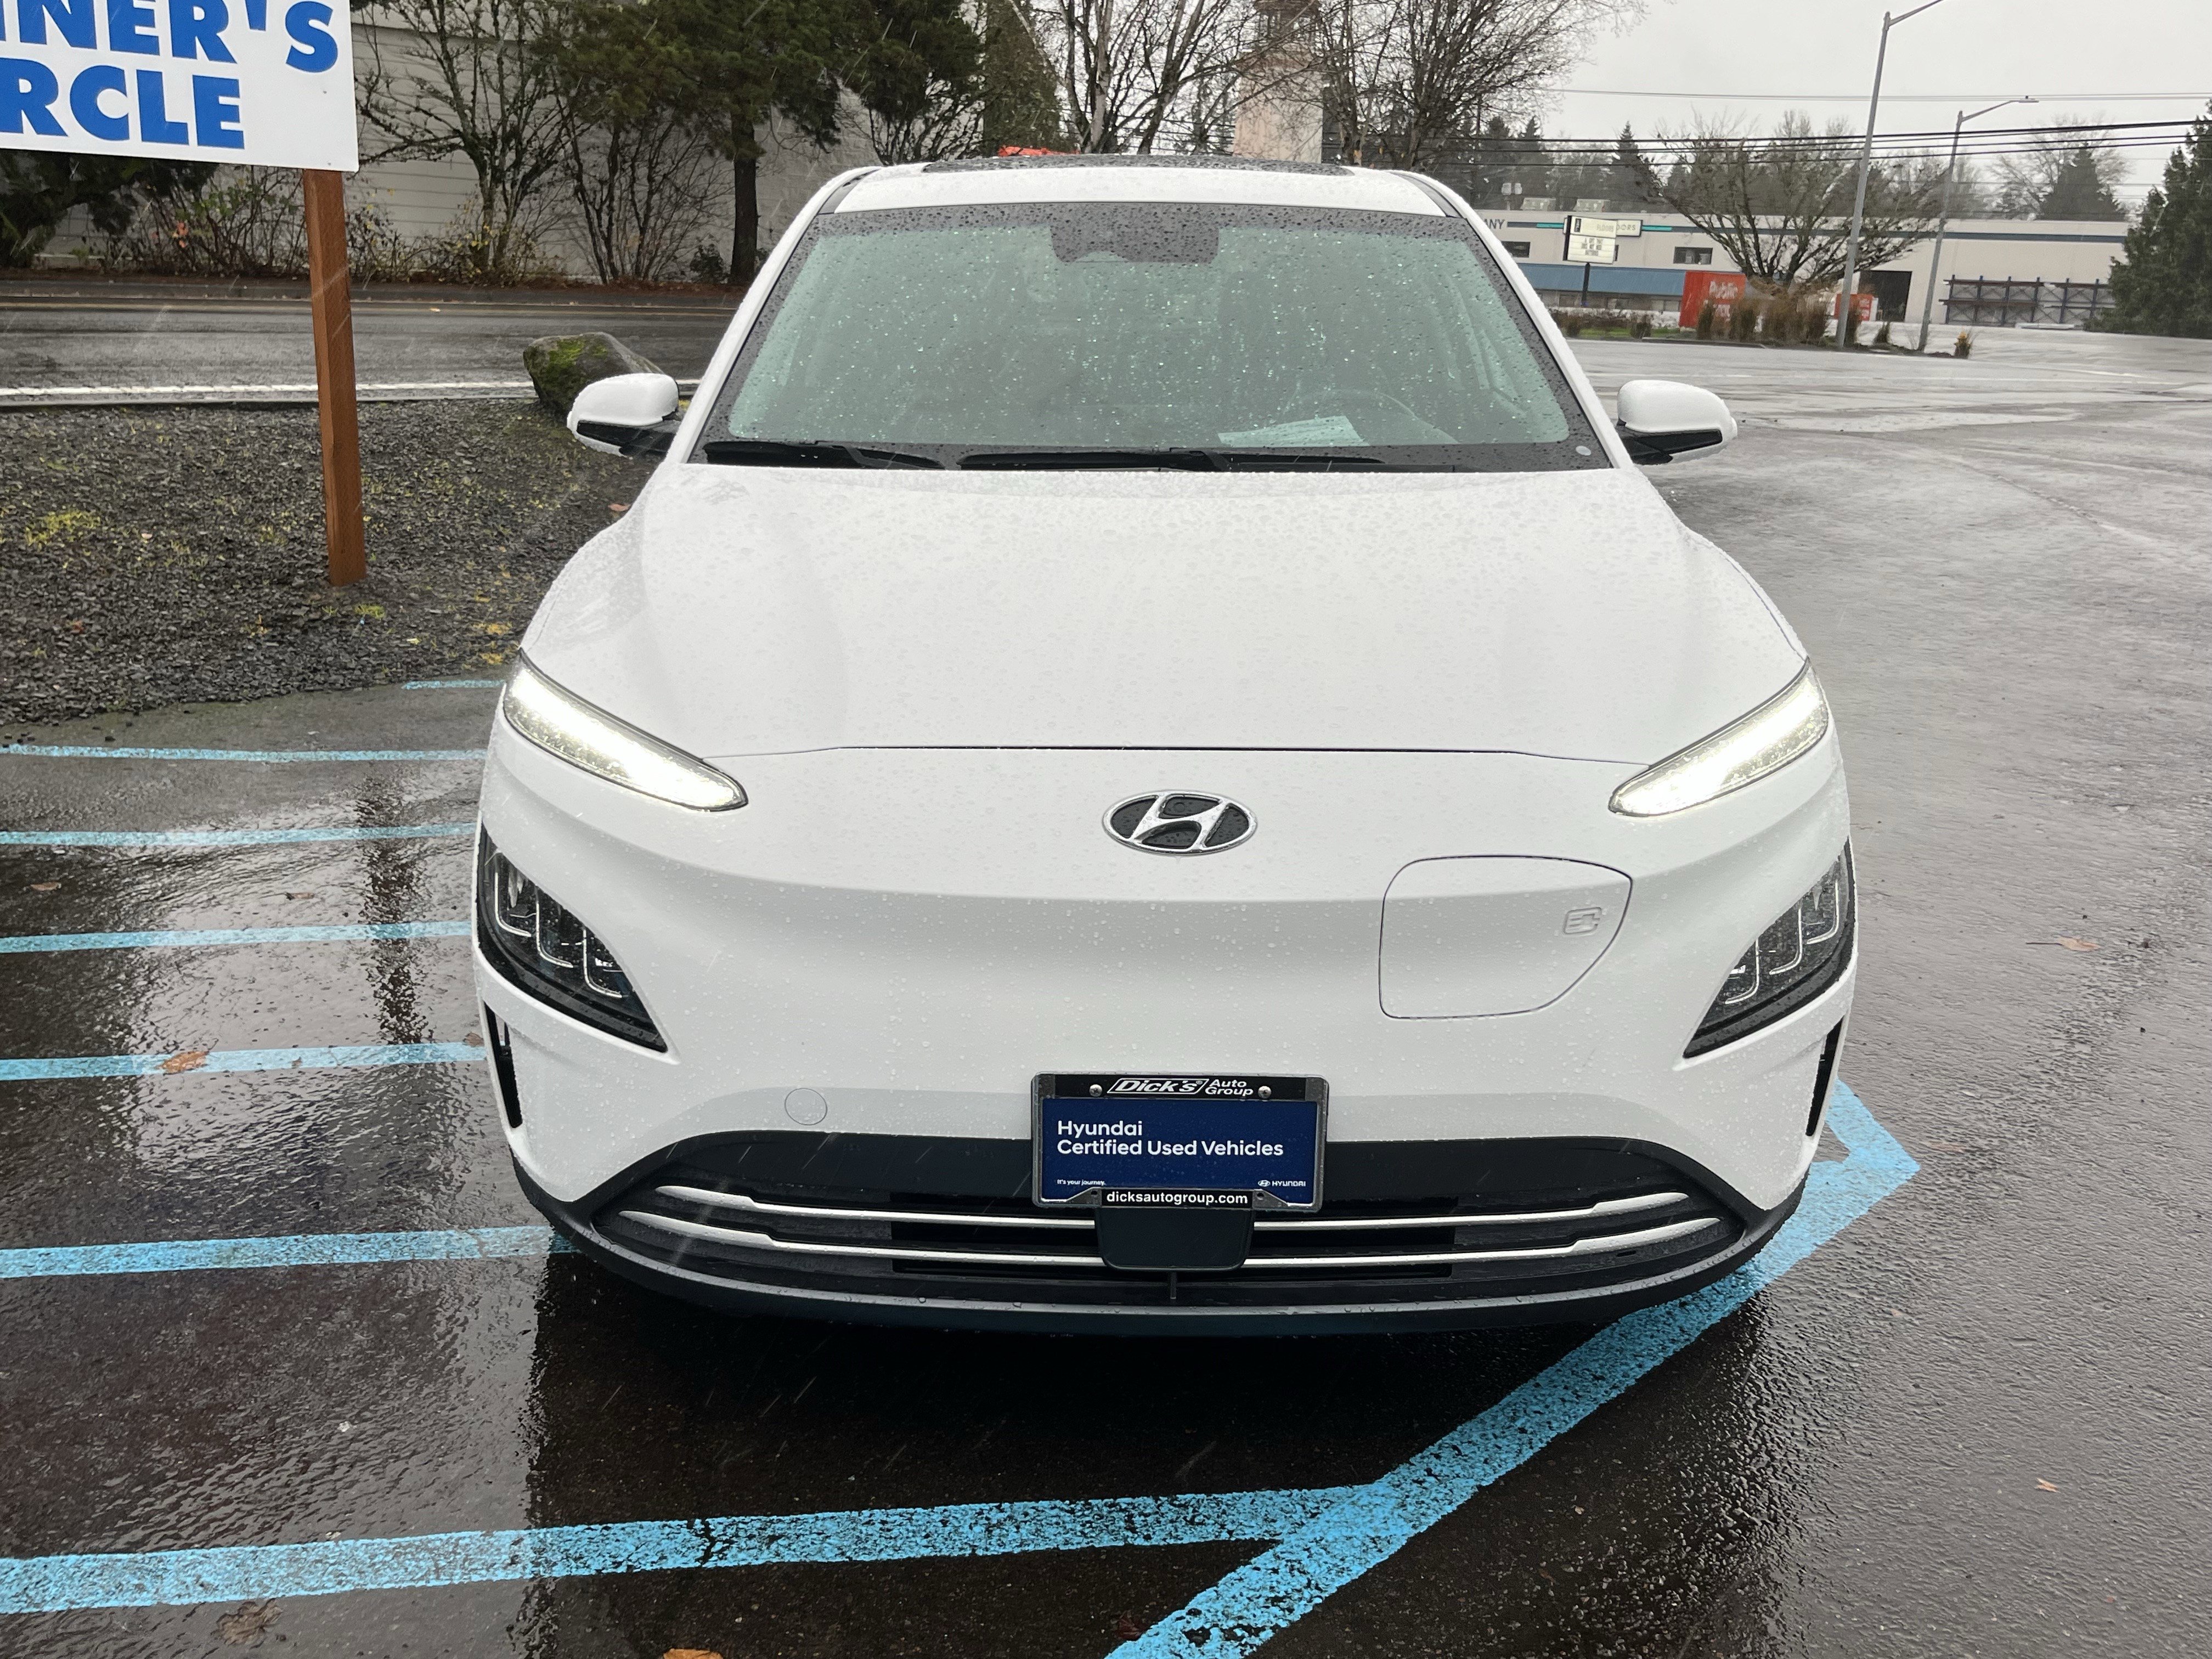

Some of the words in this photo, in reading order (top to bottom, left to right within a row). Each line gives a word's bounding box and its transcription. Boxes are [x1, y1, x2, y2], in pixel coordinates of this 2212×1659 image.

[0, 0, 338, 72] NER'S
[0, 58, 245, 149] RCLE
[1209, 1079, 1247, 1088] Auto
[1205, 1087, 1254, 1097] Group
[1058, 1120, 1142, 1138] Hyundai
[1057, 1139, 1142, 1155] Certified
[1148, 1140, 1197, 1155] Used
[1201, 1140, 1283, 1155] Vehicles
[1107, 1191, 1248, 1205] dicksautogroup.com
